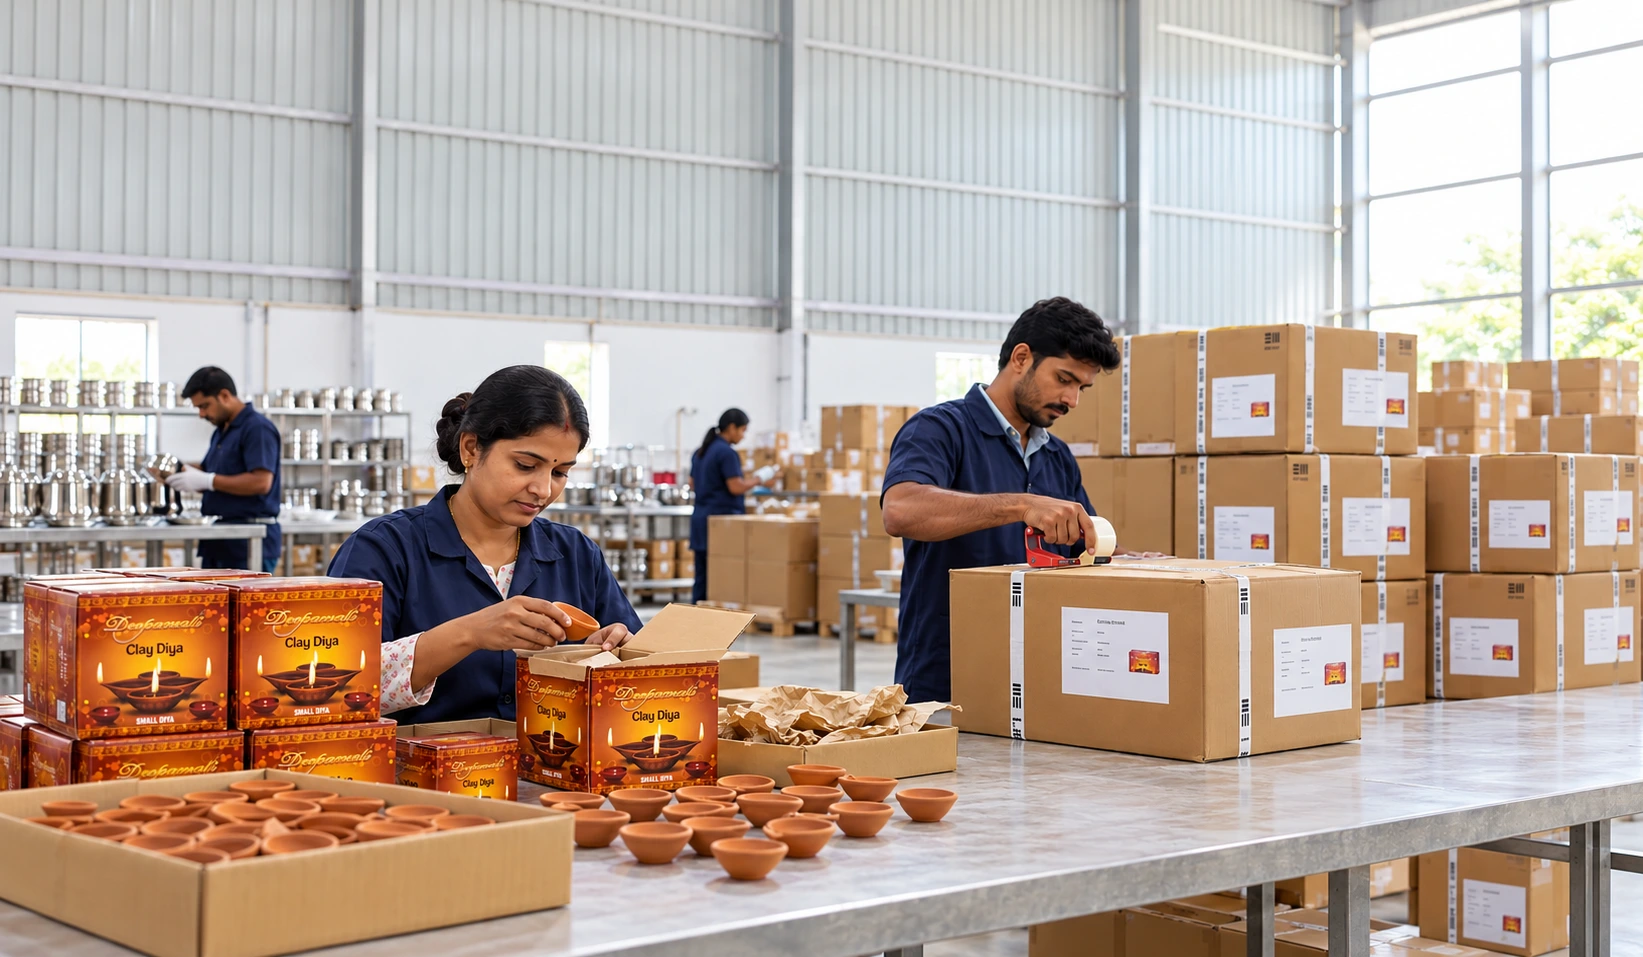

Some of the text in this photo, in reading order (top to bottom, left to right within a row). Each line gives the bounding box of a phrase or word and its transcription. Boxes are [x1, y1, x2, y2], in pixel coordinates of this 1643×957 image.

[126, 642, 184, 657] Clay Diya
[285, 635, 339, 650] Clay Diya
[136, 717, 158, 725] SMALL
[632, 710, 680, 723] Clay Diya
